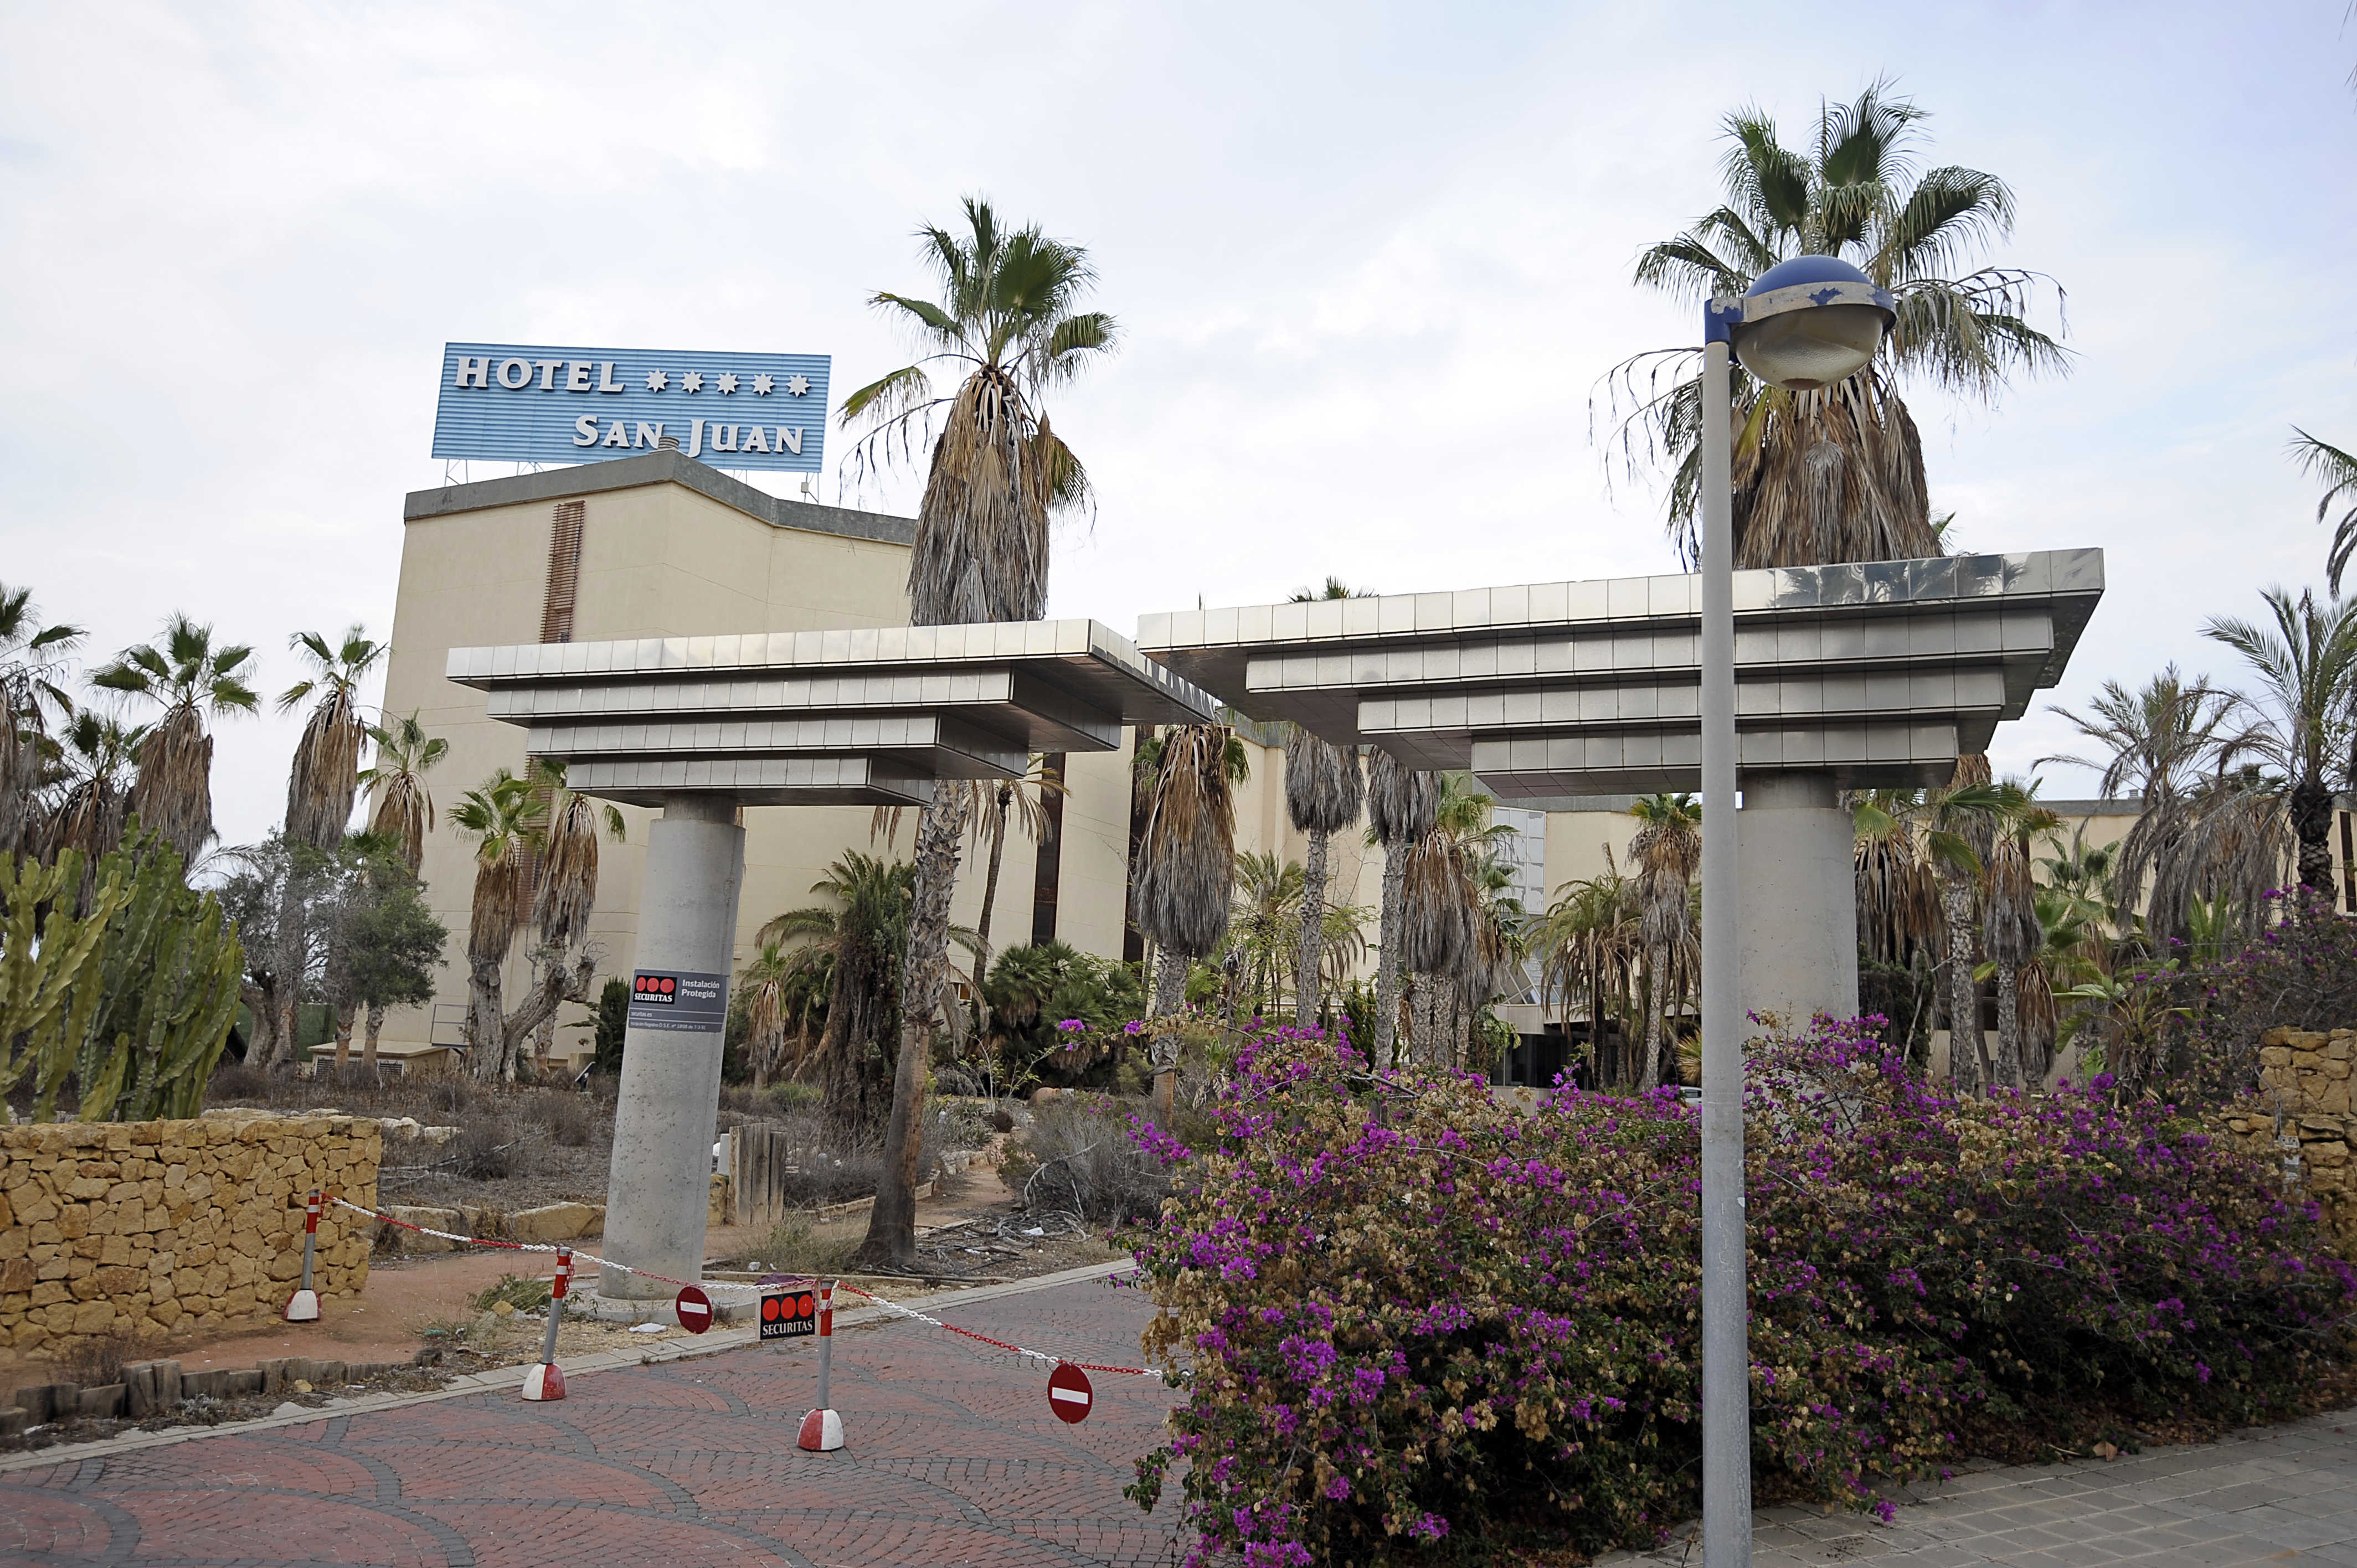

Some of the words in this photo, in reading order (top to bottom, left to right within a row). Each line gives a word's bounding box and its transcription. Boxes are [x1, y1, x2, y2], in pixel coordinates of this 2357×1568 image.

[454, 356, 626, 393] HOTEL
[572, 414, 665, 450] SAN
[687, 419, 804, 458] JUAN
[682, 979, 720, 989] Instalación
[634, 993, 673, 1002] SECURITAS
[681, 988, 717, 999] Protegida
[762, 1320, 813, 1335] SECURITAS
